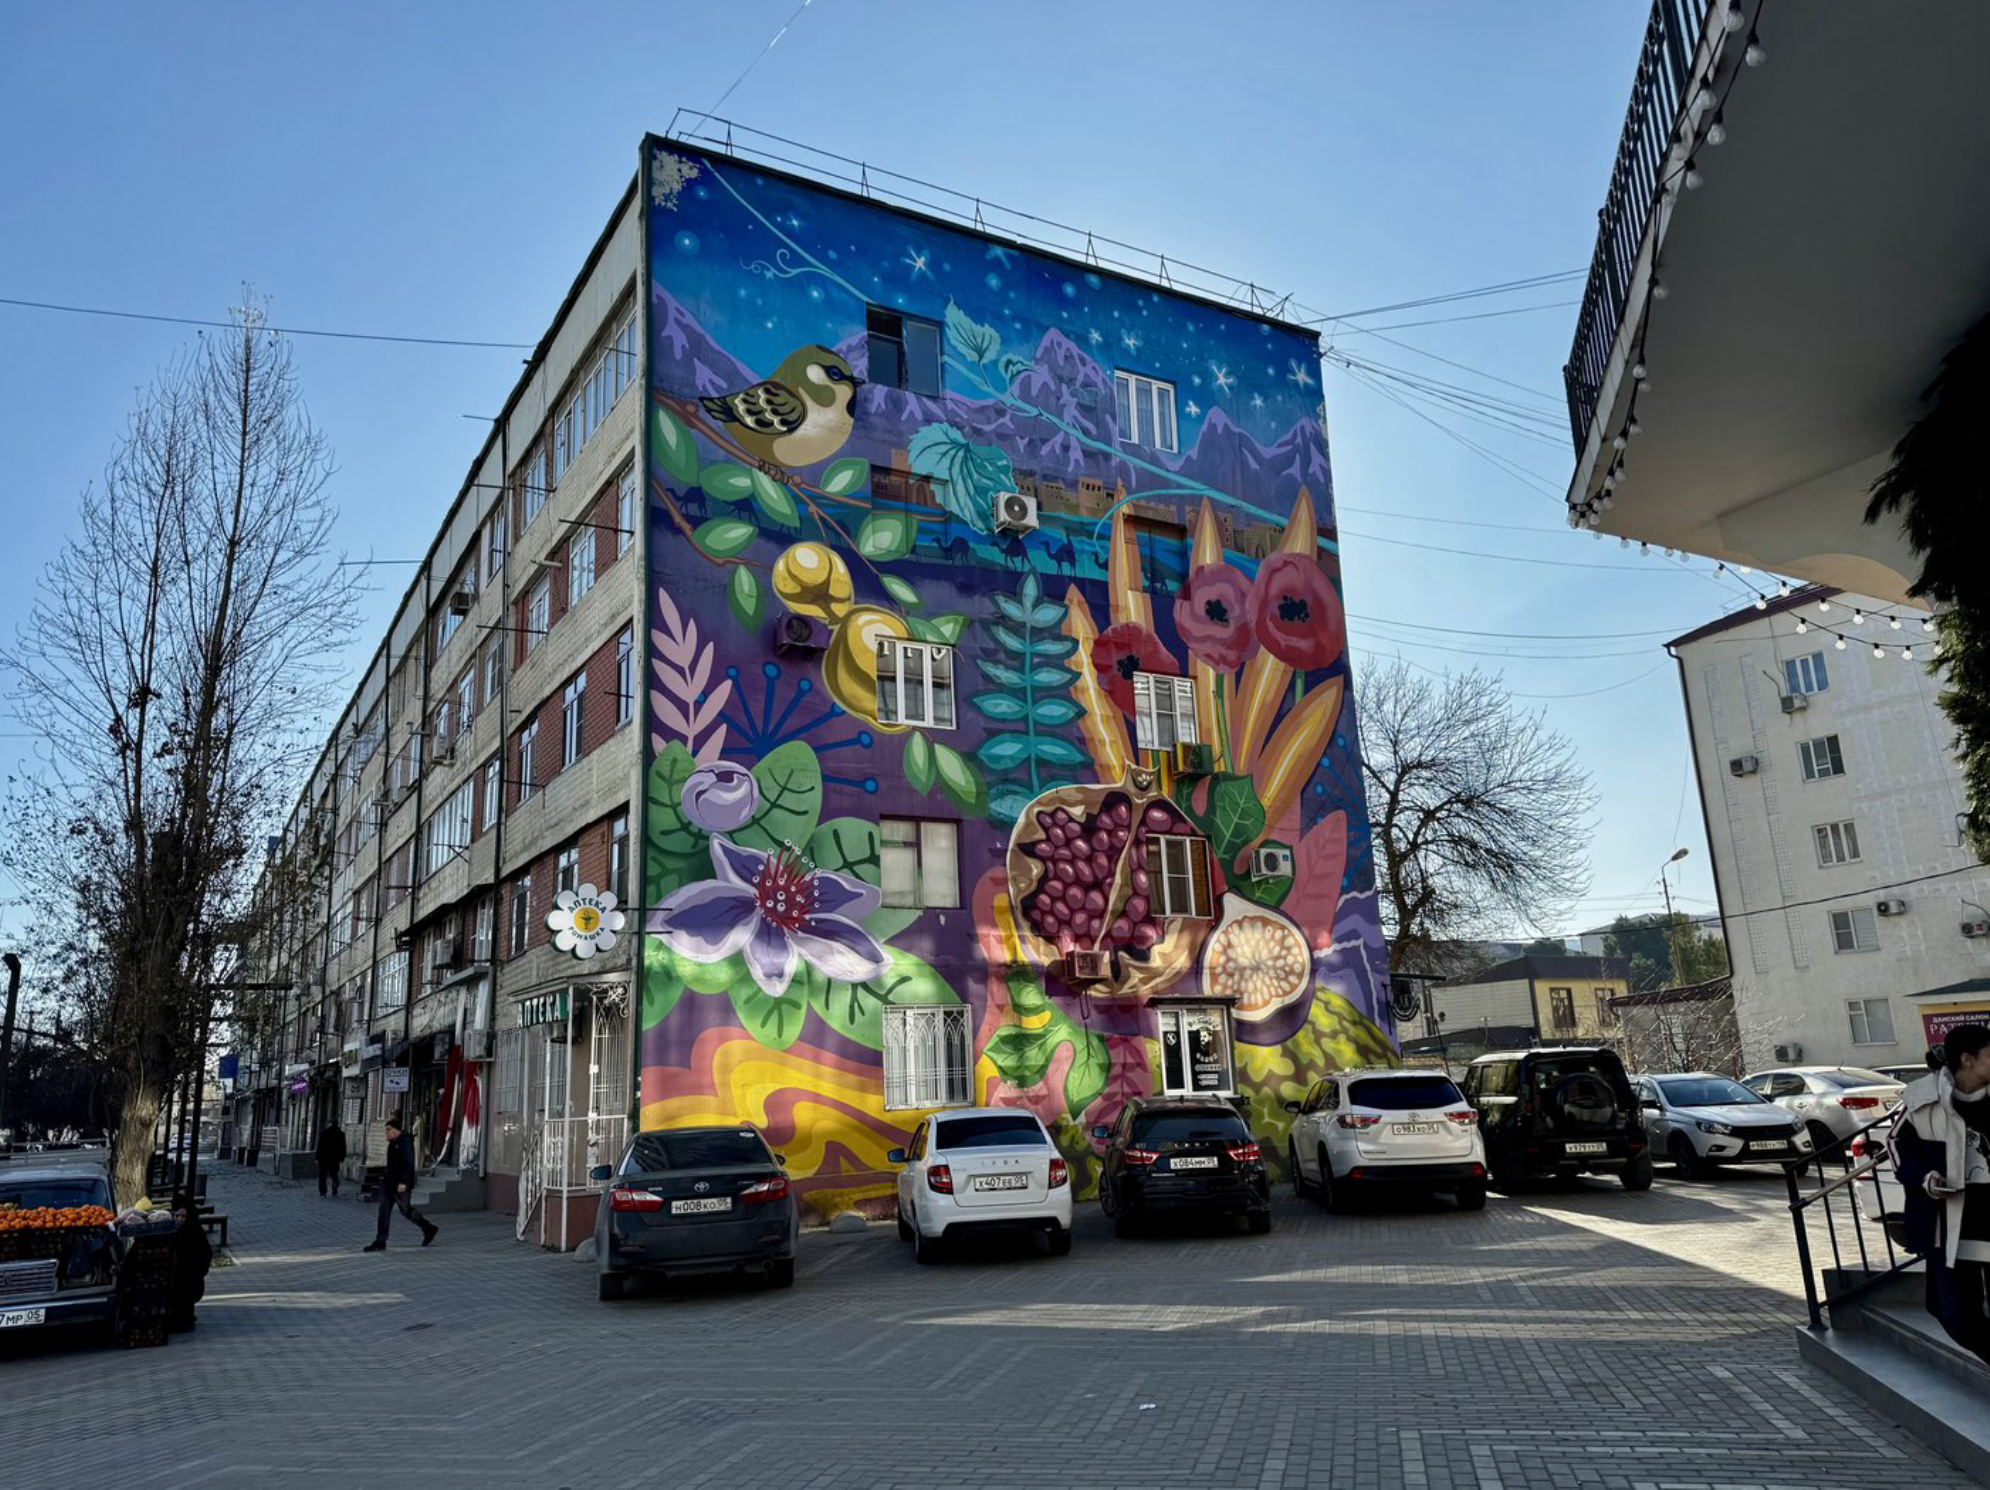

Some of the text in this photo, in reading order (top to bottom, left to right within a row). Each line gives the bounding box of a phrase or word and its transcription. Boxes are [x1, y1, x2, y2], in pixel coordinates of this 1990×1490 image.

[567, 898, 607, 914] АПТЕКА
[568, 927, 606, 941] РОМАШКА
[517, 992, 561, 1028] АПТЕКА
[1932, 1012, 1989, 1024] ДАМСКИЙ САЛОН
[978, 1176, 1013, 1187] Х407ЕЕ
[674, 1201, 716, 1213] Н008КО
[27, 1310, 41, 1321] 05
